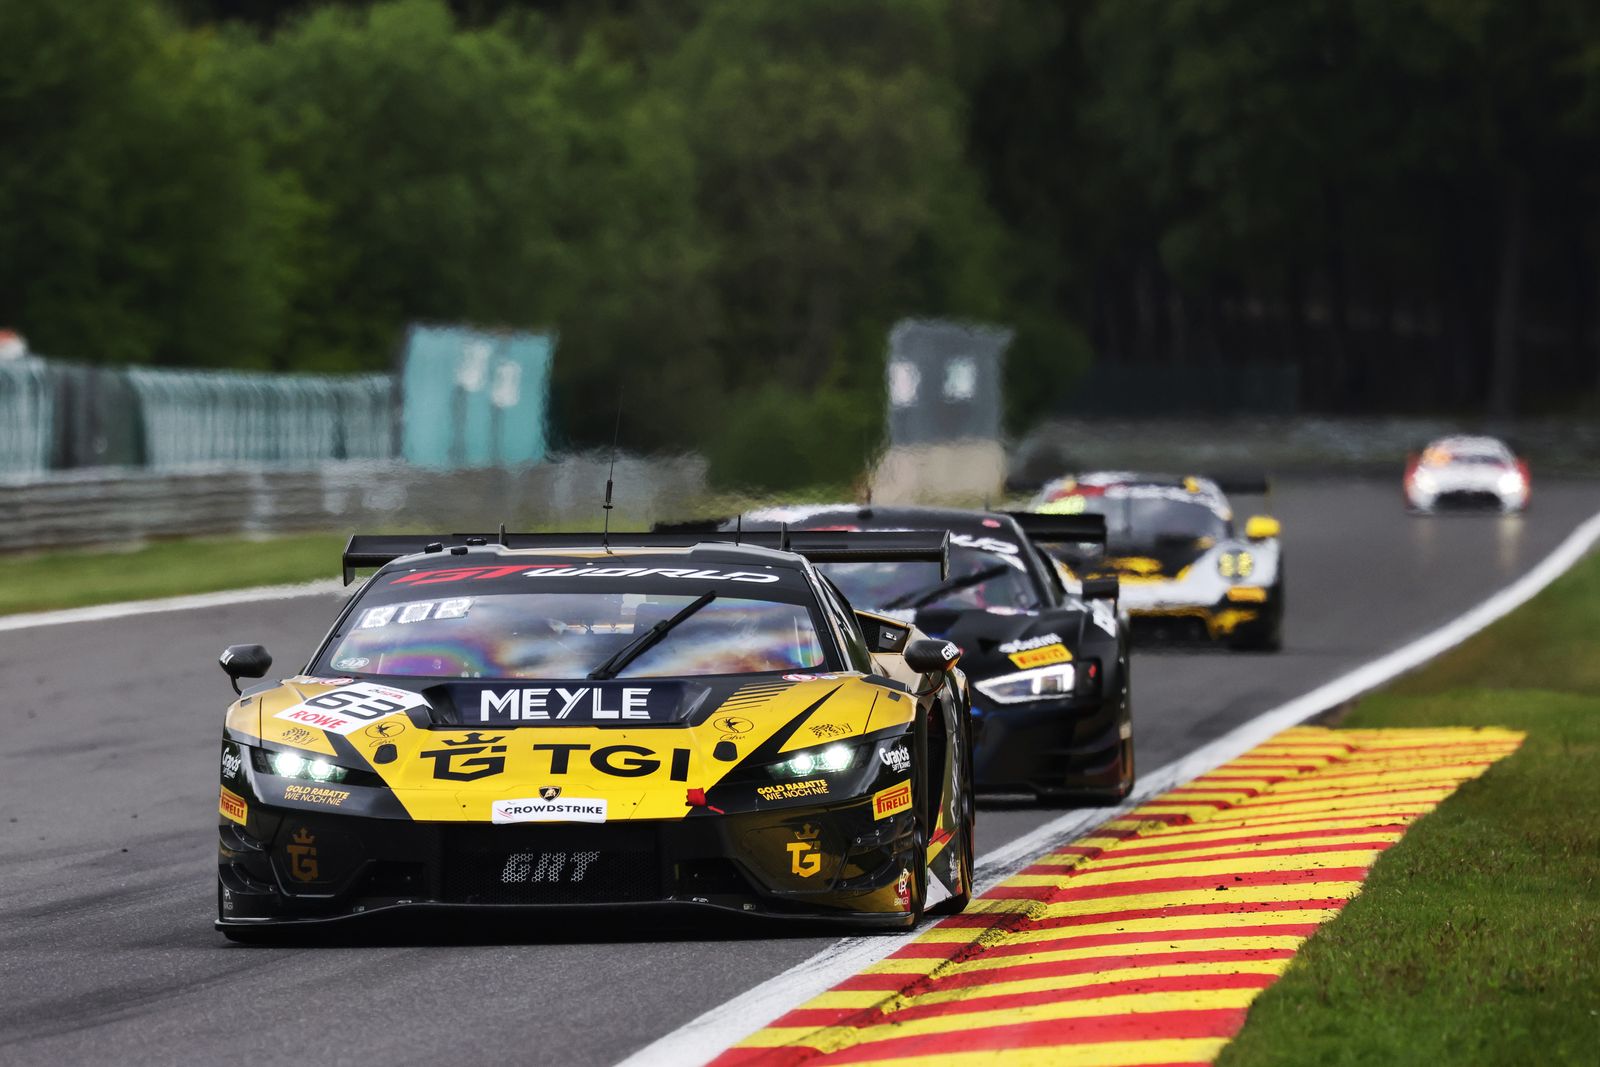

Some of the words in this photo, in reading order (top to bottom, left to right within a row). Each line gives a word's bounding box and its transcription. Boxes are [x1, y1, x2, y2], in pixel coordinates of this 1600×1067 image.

[304, 690, 406, 720] 63
[480, 688, 652, 721] MEYLE
[288, 709, 349, 730] ROWE
[533, 743, 692, 782] TGI
[286, 784, 312, 794] GOLD
[311, 787, 350, 800] RABATTE
[757, 784, 785, 795] GOLD
[784, 779, 828, 791] RABATTE
[762, 792, 784, 801] WIE
[783, 788, 812, 799] NOCH
[811, 786, 830, 795] NIE
[220, 791, 245, 820] PIRELLI
[284, 792, 301, 801] WIE
[301, 794, 327, 804] NOCH
[327, 797, 343, 806] NIE
[504, 804, 604, 815] CROWDSTRIKE
[876, 786, 910, 815] PIRELLI
